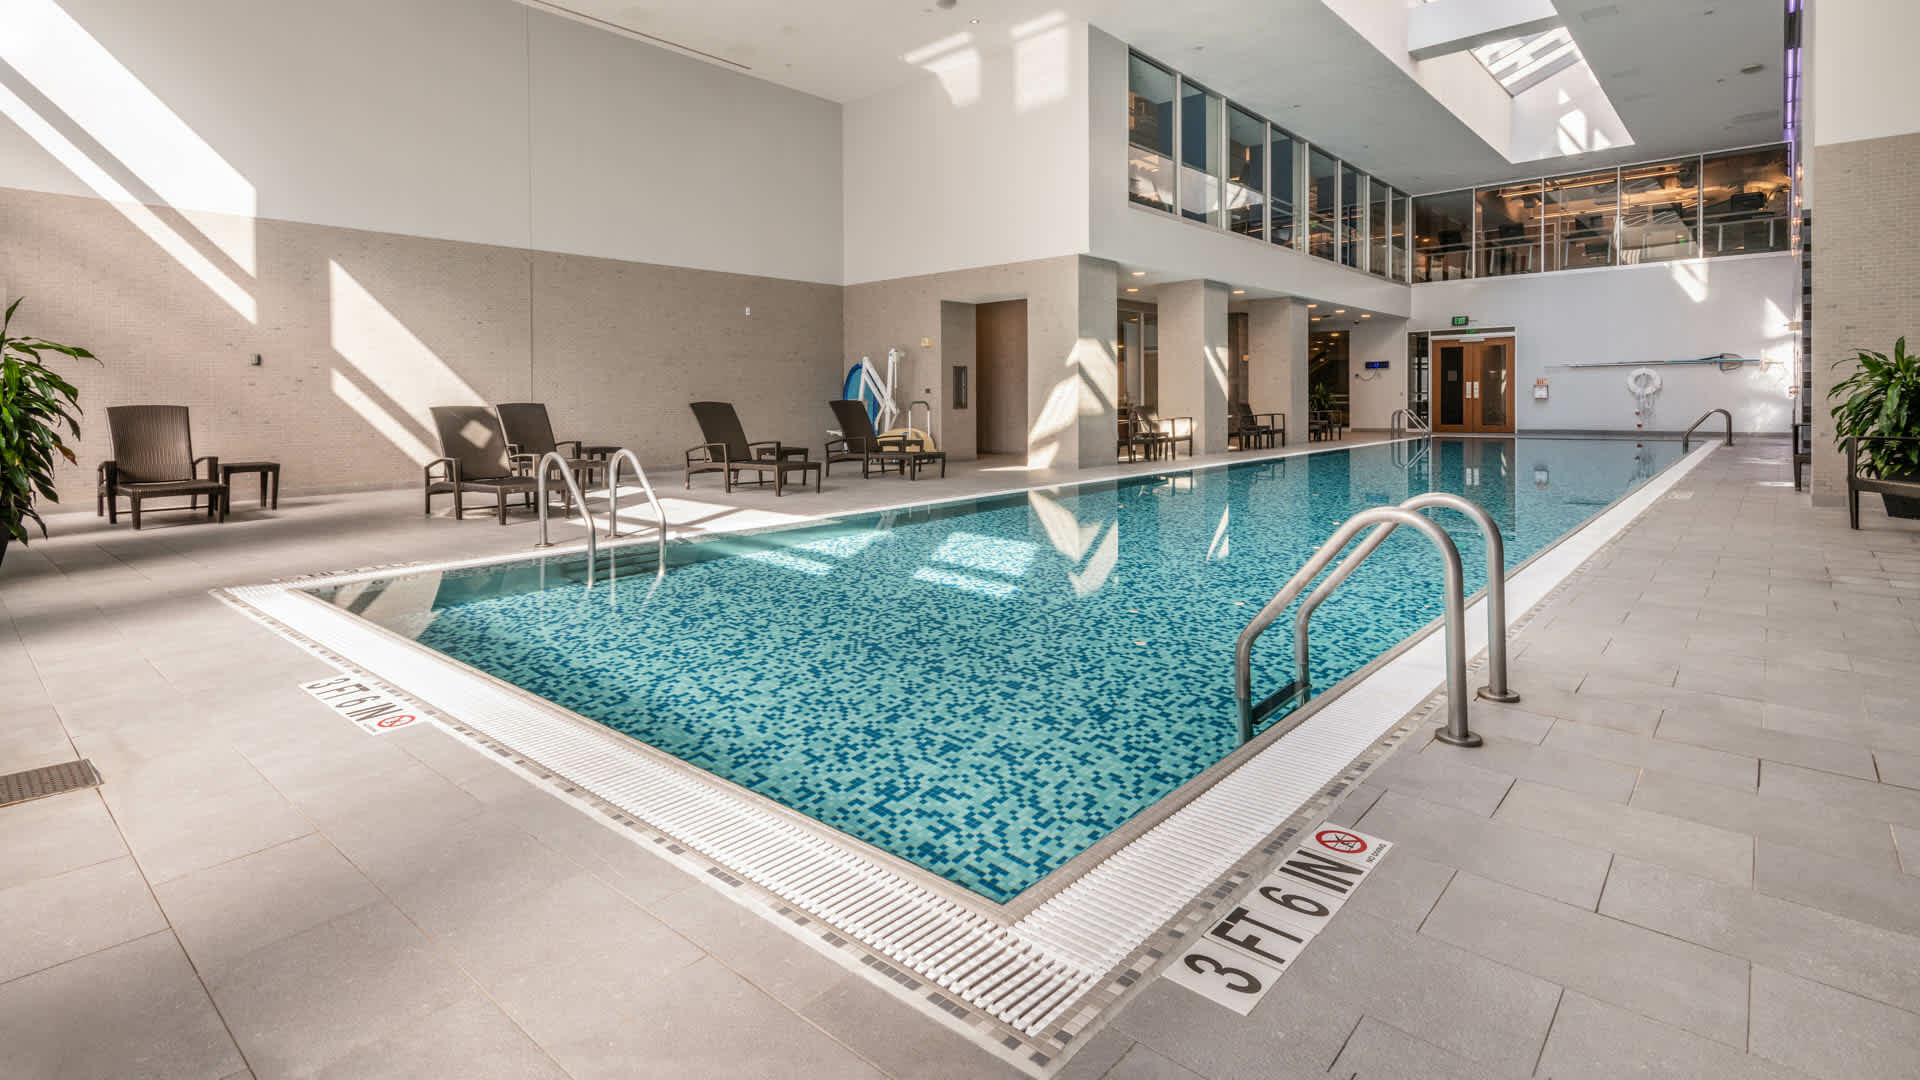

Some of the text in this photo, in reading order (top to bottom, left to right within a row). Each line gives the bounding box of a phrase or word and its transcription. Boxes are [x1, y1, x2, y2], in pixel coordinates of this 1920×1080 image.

[306, 677, 404, 722] 3 FT 6 IN
[1184, 850, 1365, 994] 3 FT 6 IN
